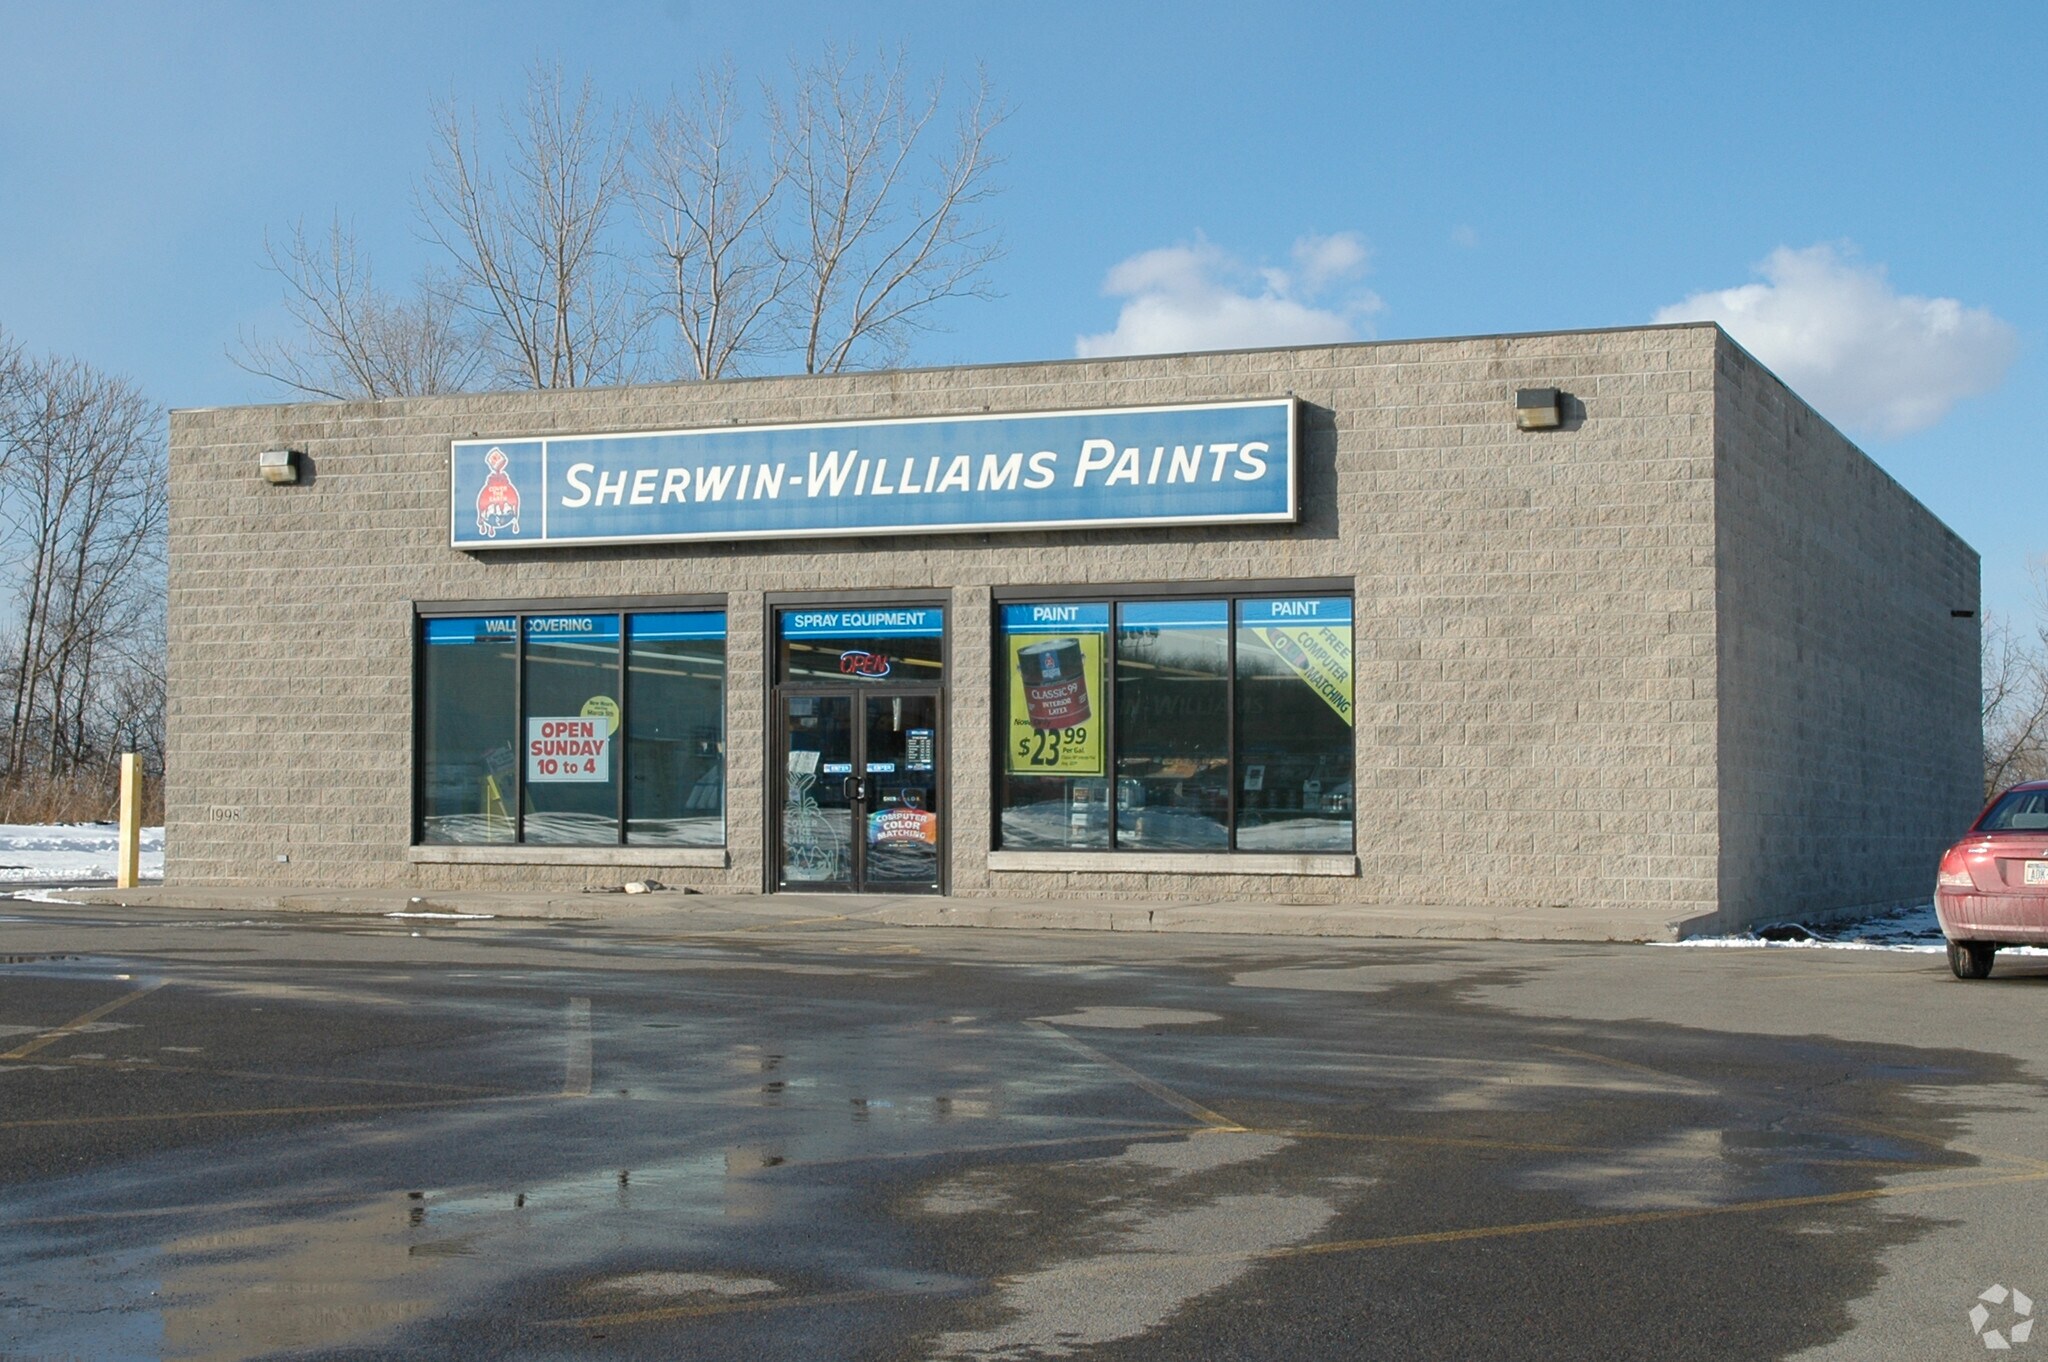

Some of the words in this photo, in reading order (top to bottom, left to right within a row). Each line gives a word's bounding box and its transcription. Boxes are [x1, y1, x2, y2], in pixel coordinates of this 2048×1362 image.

[561, 449, 1057, 508] SHERWIN-WILLIAMS
[1073, 438, 1269, 488] PAINTS
[1033, 607, 1078, 621] PAINT
[1271, 601, 1320, 616] PAINT
[485, 619, 517, 633] WALL
[523, 618, 593, 632] COVERING
[794, 614, 839, 628] SPRAY
[842, 612, 926, 627] EQUIPMENT
[1319, 627, 1351, 660] FREE
[840, 654, 888, 674] OPEN
[1297, 631, 1349, 683] COMPUTER
[1304, 666, 1351, 714] MATCHING
[1048, 706, 1068, 716] LATEX
[541, 722, 594, 738] OPEN
[530, 740, 604, 757] SUNDAY
[537, 758, 558, 775] 10
[563, 761, 578, 774] to
[583, 758, 596, 774] 4
[211, 808, 240, 822] 1998
[876, 813, 928, 823] COMPUTER
[883, 821, 920, 831] COLOR
[877, 829, 926, 841] MATCHING
